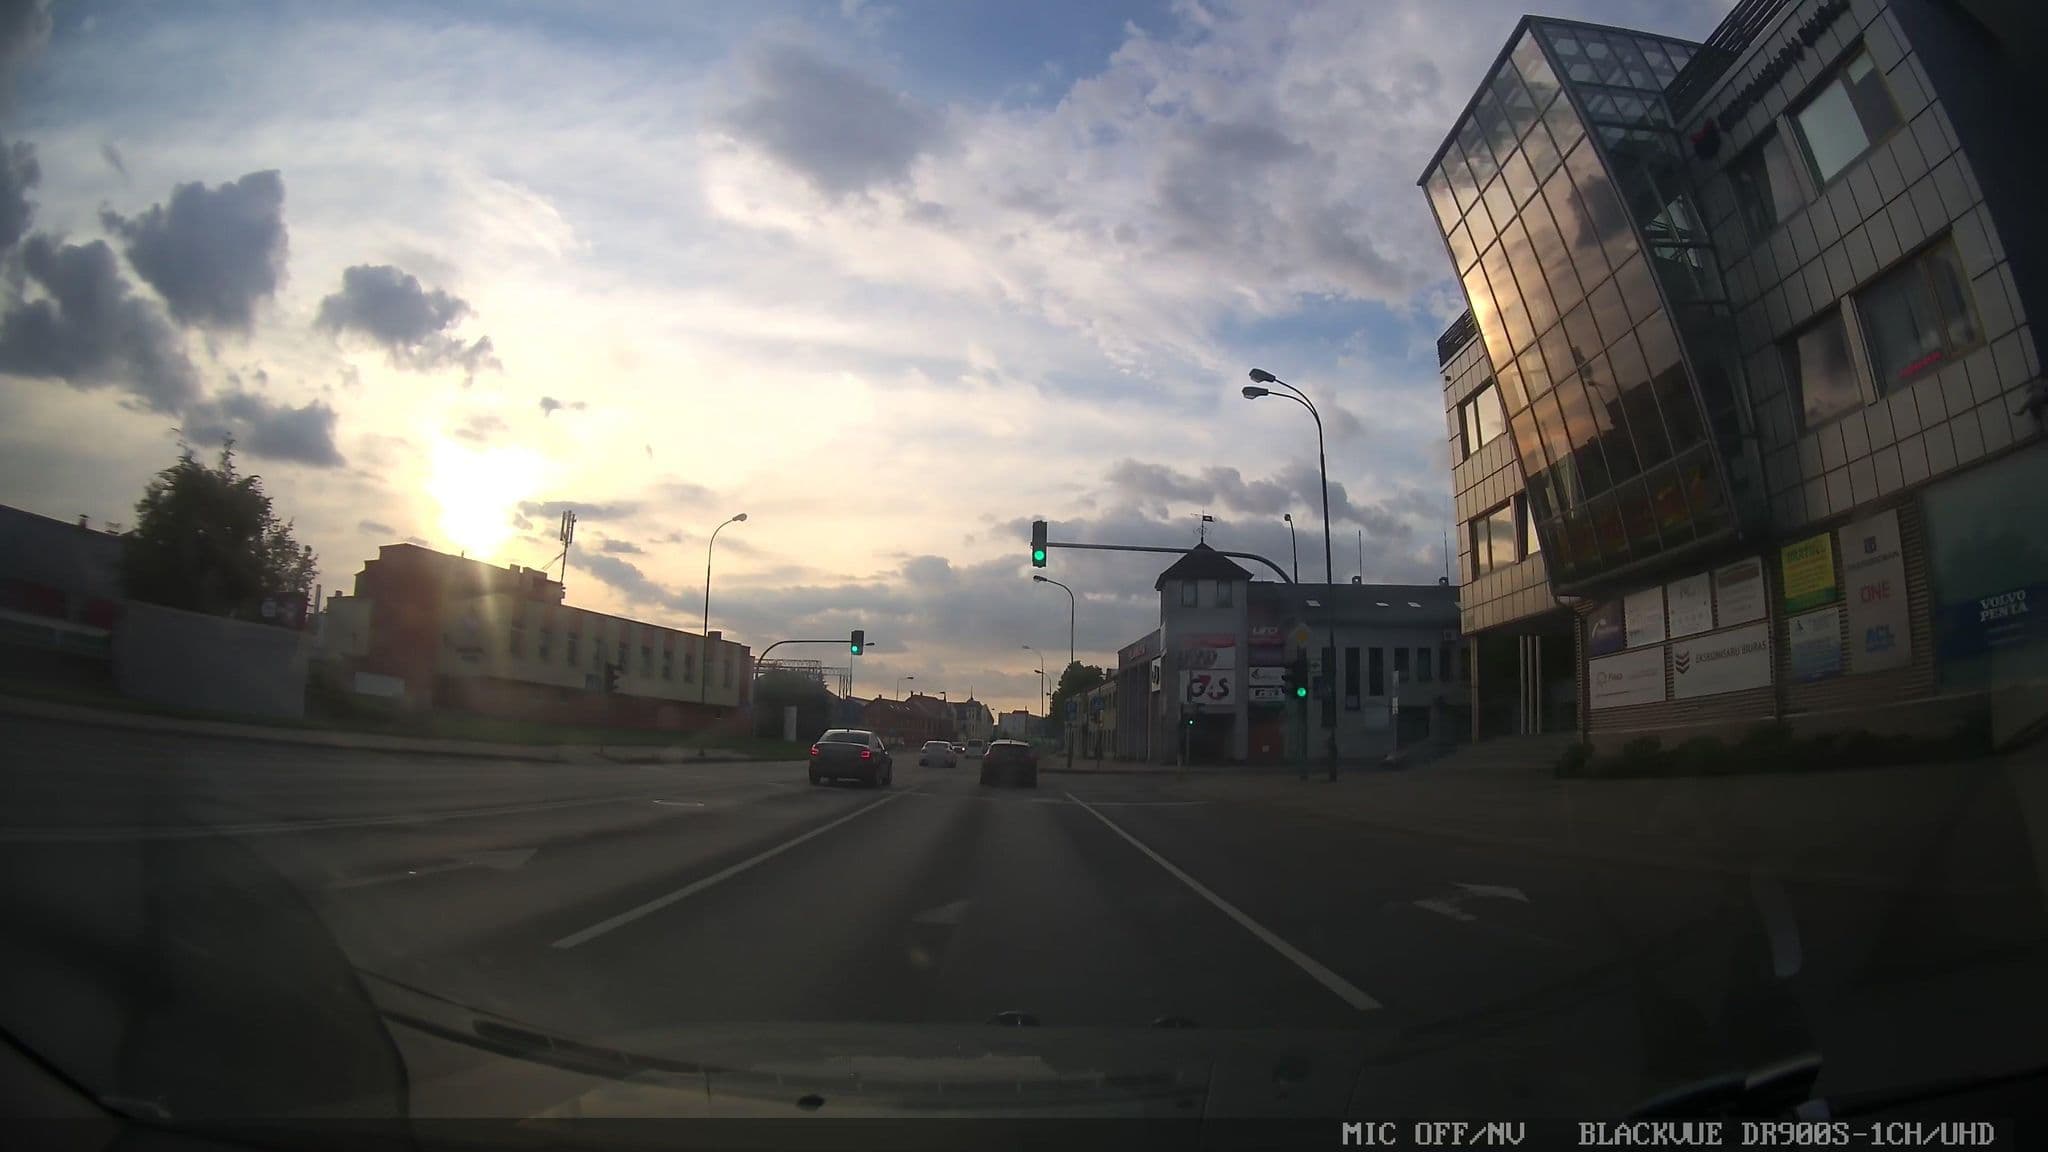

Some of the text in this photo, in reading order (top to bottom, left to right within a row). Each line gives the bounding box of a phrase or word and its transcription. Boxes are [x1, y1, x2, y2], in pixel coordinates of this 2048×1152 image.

[1859, 580, 1892, 603] ONE
[1980, 589, 2026, 610] VOLVO
[1979, 601, 2029, 623] PENTA
